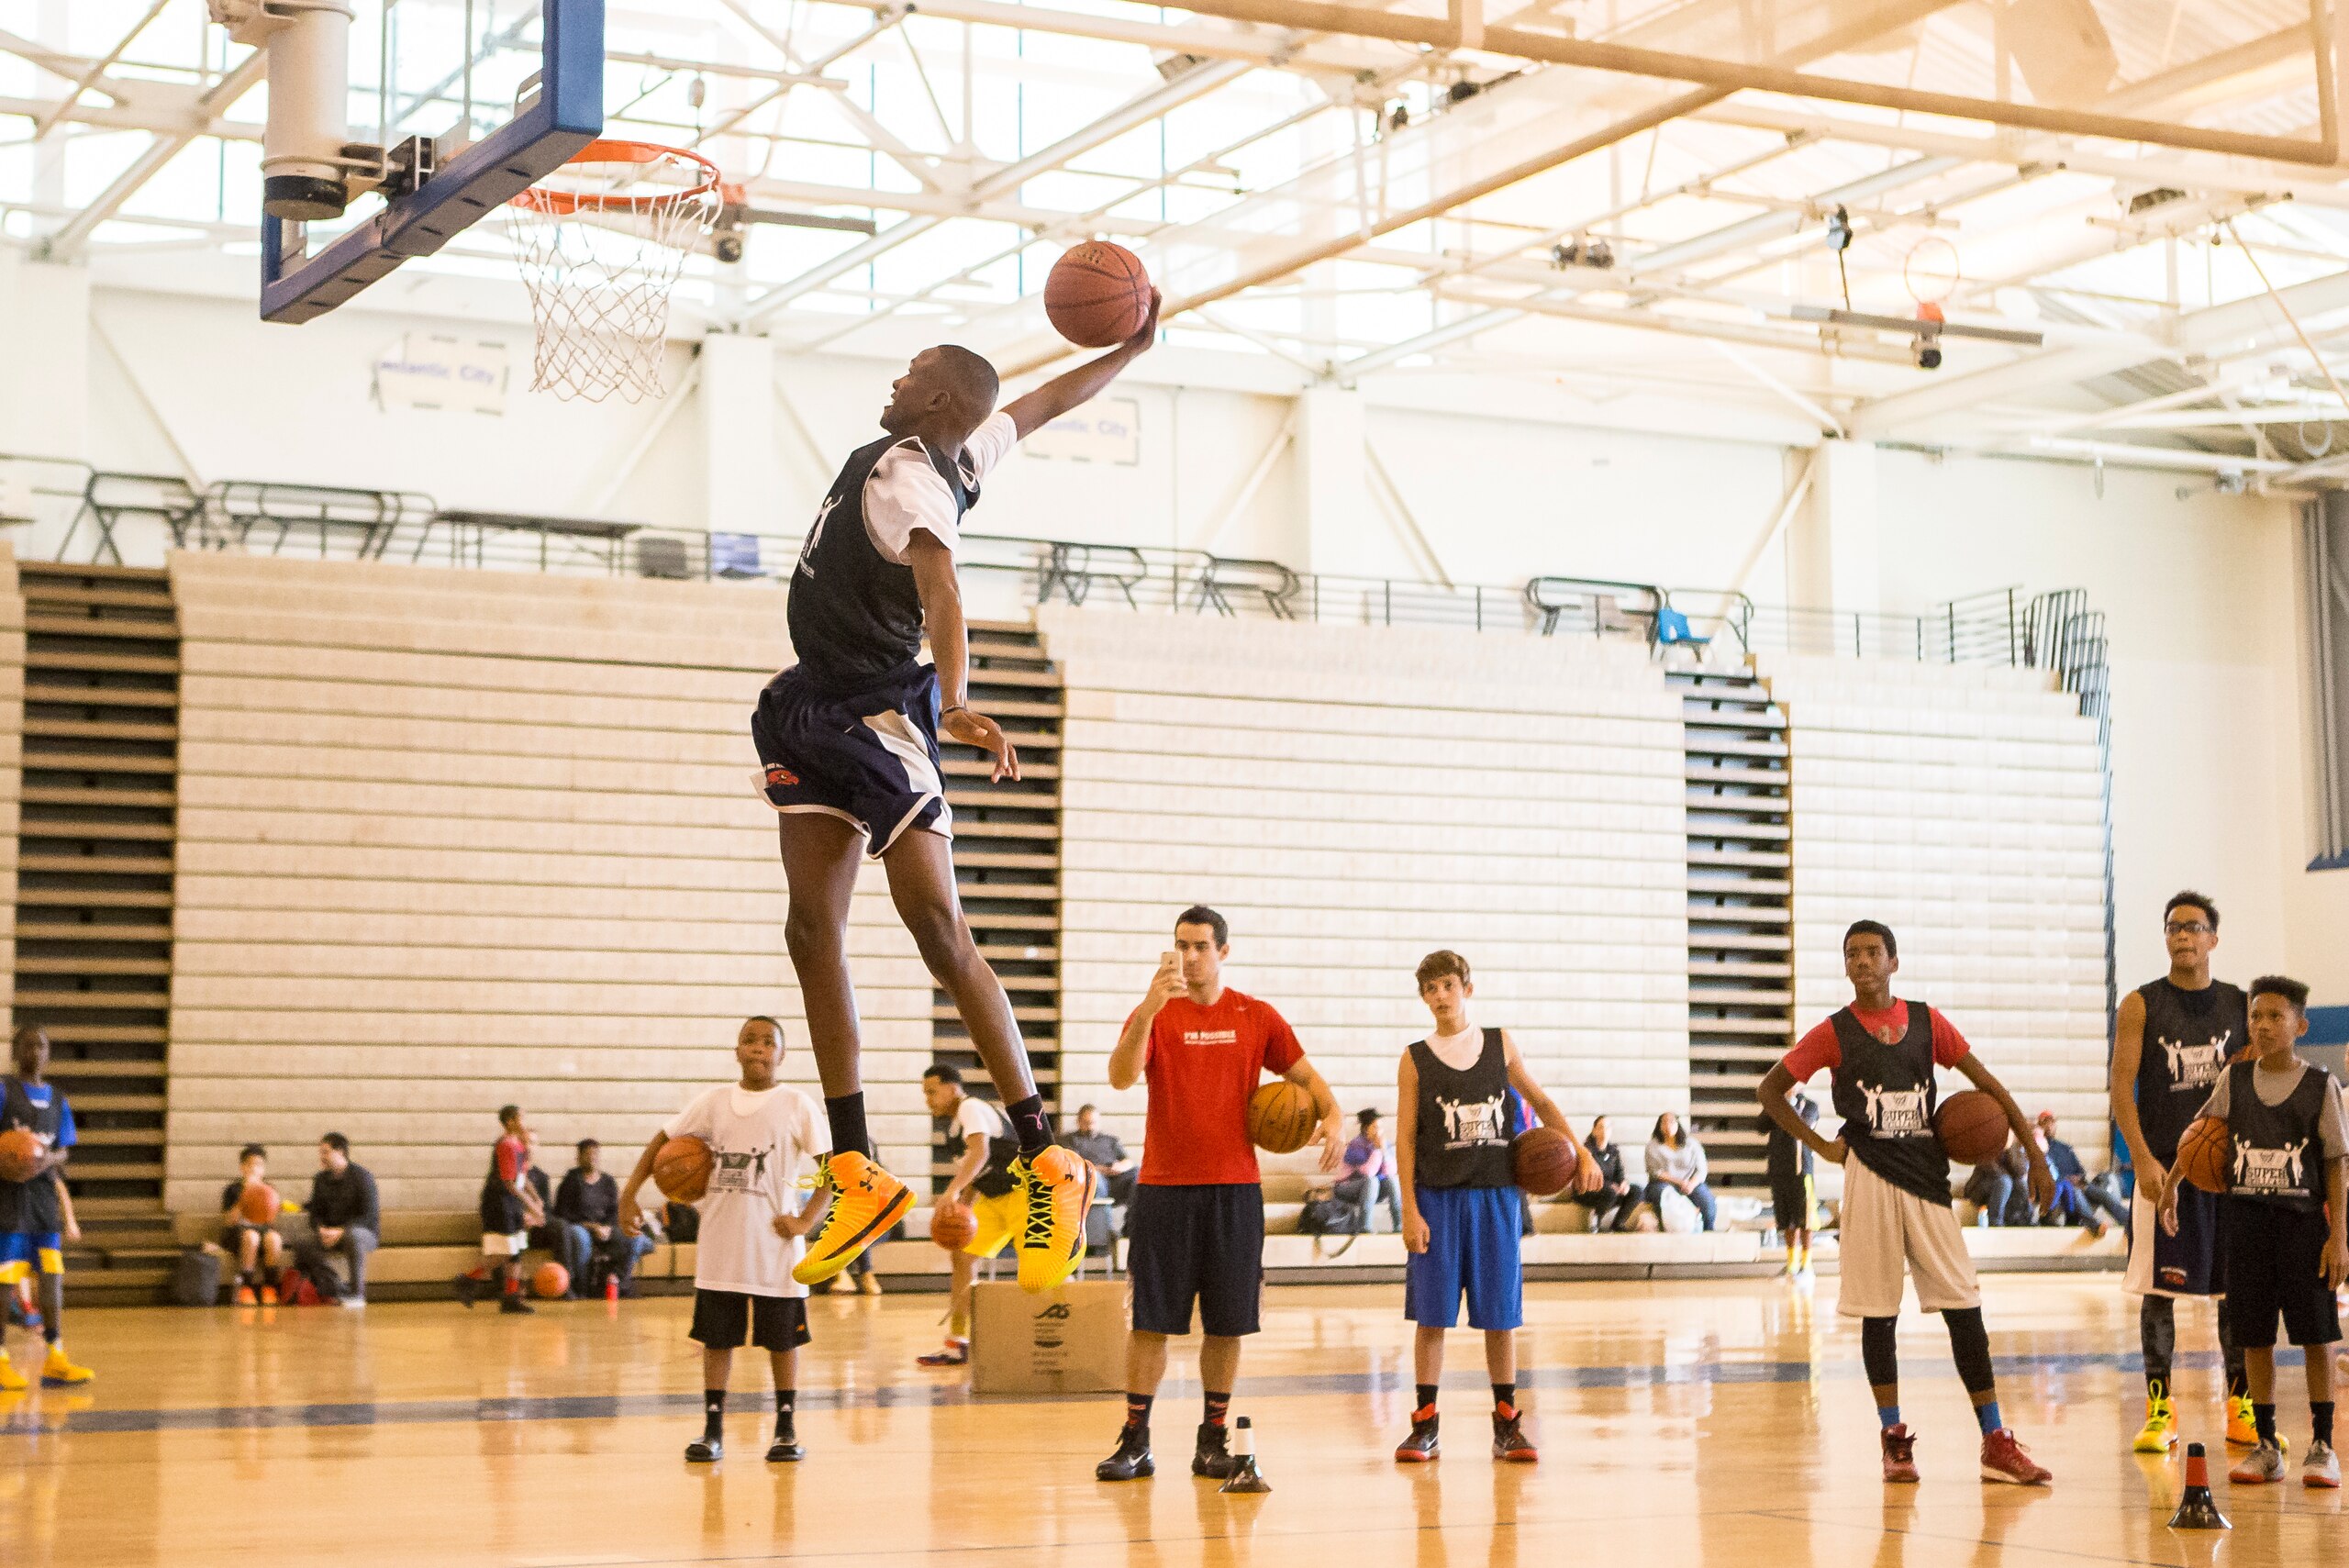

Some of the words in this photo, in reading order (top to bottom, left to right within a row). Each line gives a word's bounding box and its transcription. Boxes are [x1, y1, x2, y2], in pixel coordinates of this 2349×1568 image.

[460, 364, 495, 385] City
[1882, 1110, 1919, 1122] SUPER
[2246, 1166, 2287, 1178] SUPER
